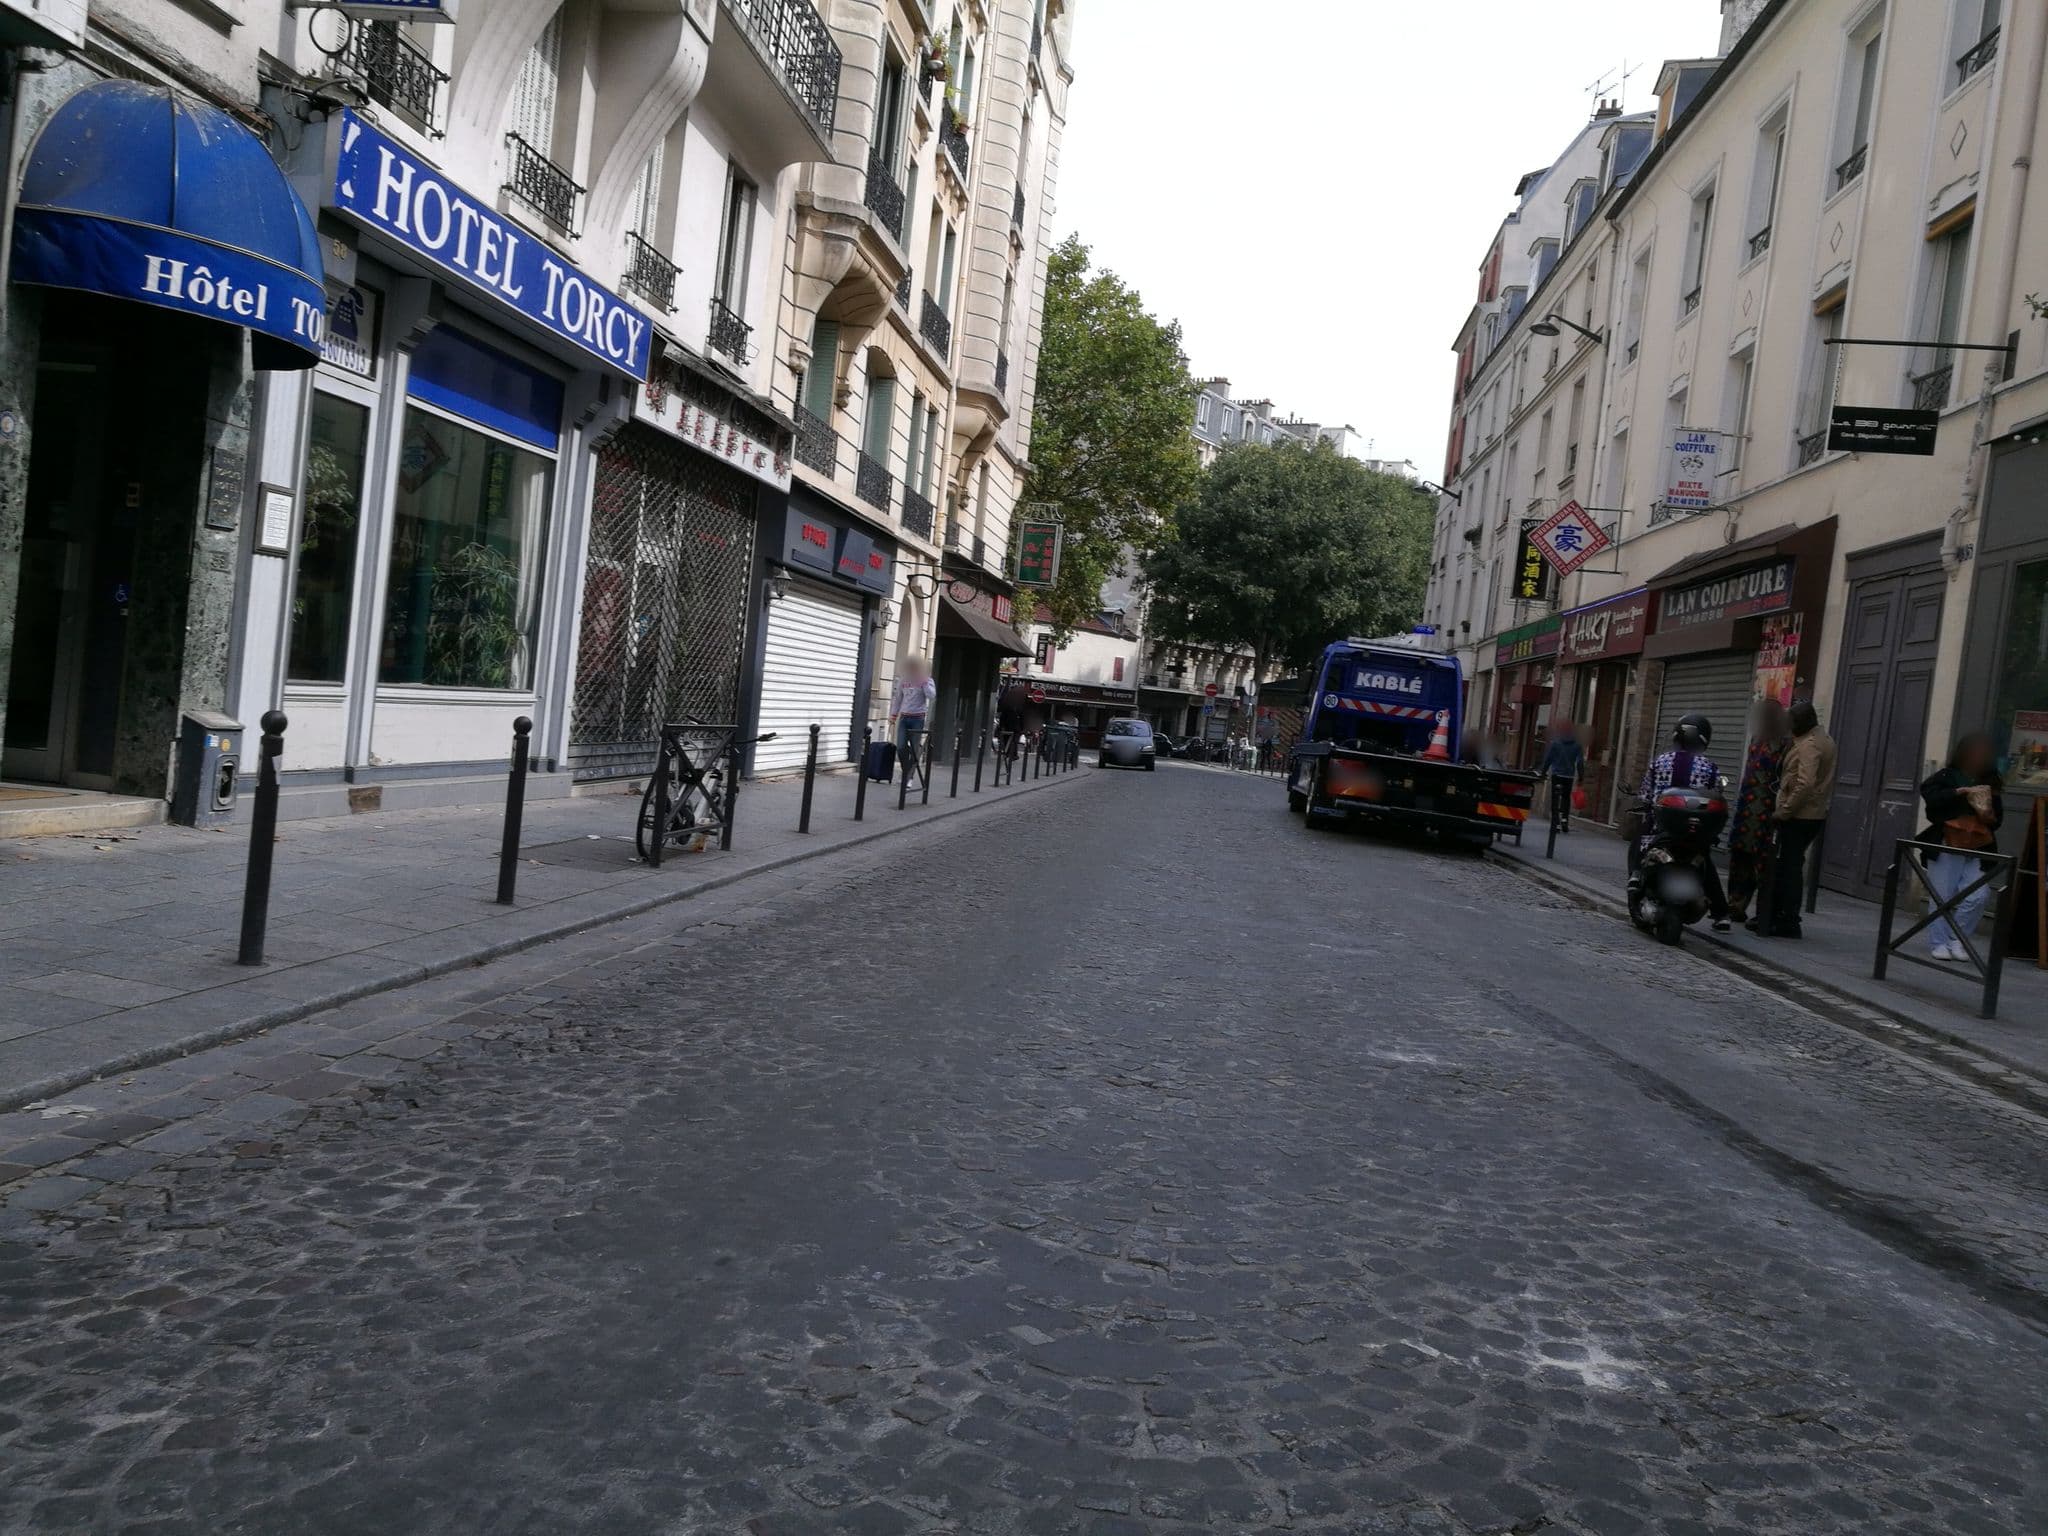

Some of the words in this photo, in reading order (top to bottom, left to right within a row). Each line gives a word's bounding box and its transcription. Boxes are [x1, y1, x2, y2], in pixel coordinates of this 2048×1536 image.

[373, 145, 524, 300] HOTEL
[542, 258, 644, 368] TORCY
[141, 254, 269, 321] Hôtel
[292, 297, 325, 347] TO
[1688, 433, 1706, 442] LAN
[1674, 442, 1716, 454] COIFFURE
[1668, 487, 1710, 498] MANUCURE
[1678, 480, 1703, 489] MIXTE
[1667, 590, 1697, 616] LAN
[1701, 563, 1787, 609] COIFFURE
[1355, 671, 1424, 694] KABLÉ
